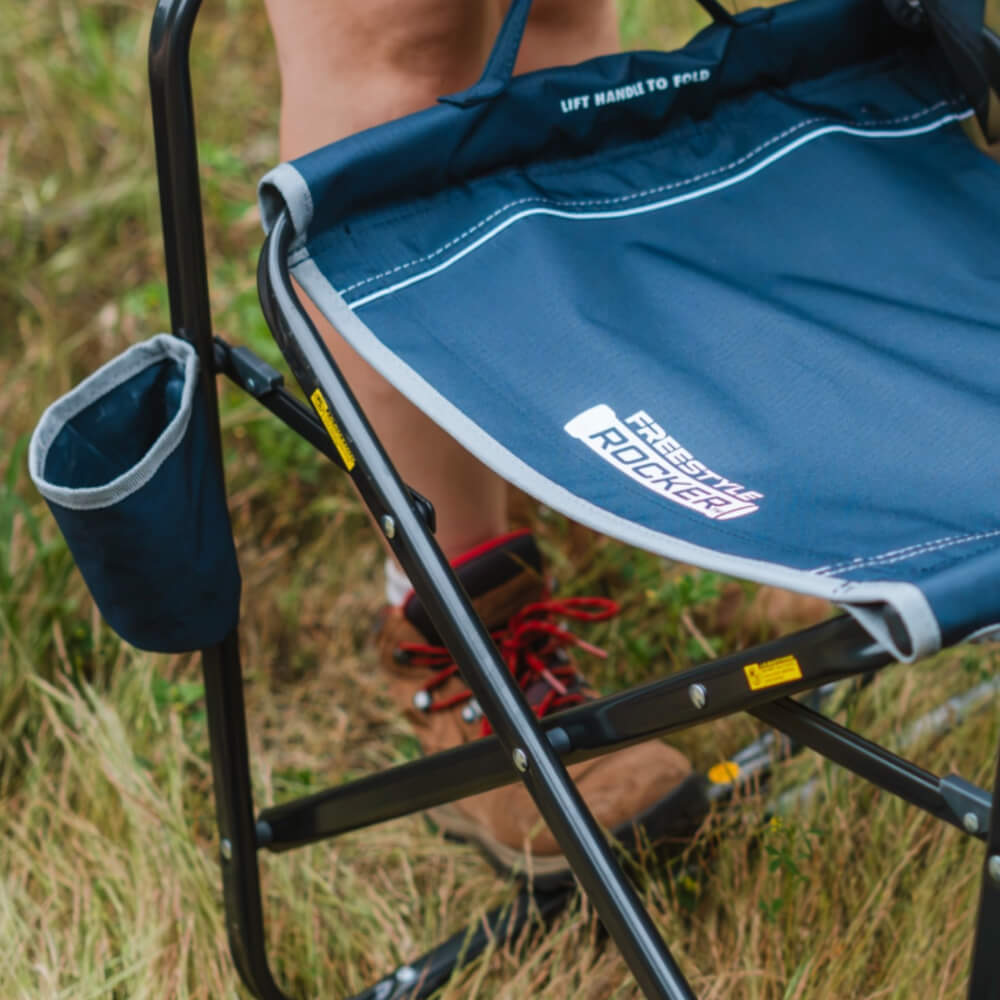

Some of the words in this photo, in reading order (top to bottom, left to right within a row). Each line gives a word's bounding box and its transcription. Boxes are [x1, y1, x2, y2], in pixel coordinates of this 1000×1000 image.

[560, 95, 590, 113] LIFT
[593, 80, 645, 106] HANDLE
[646, 76, 668, 92] TO
[672, 69, 711, 88] FOLD
[588, 426, 732, 510] ROCKER
[624, 410, 765, 502] FREESTYLE
